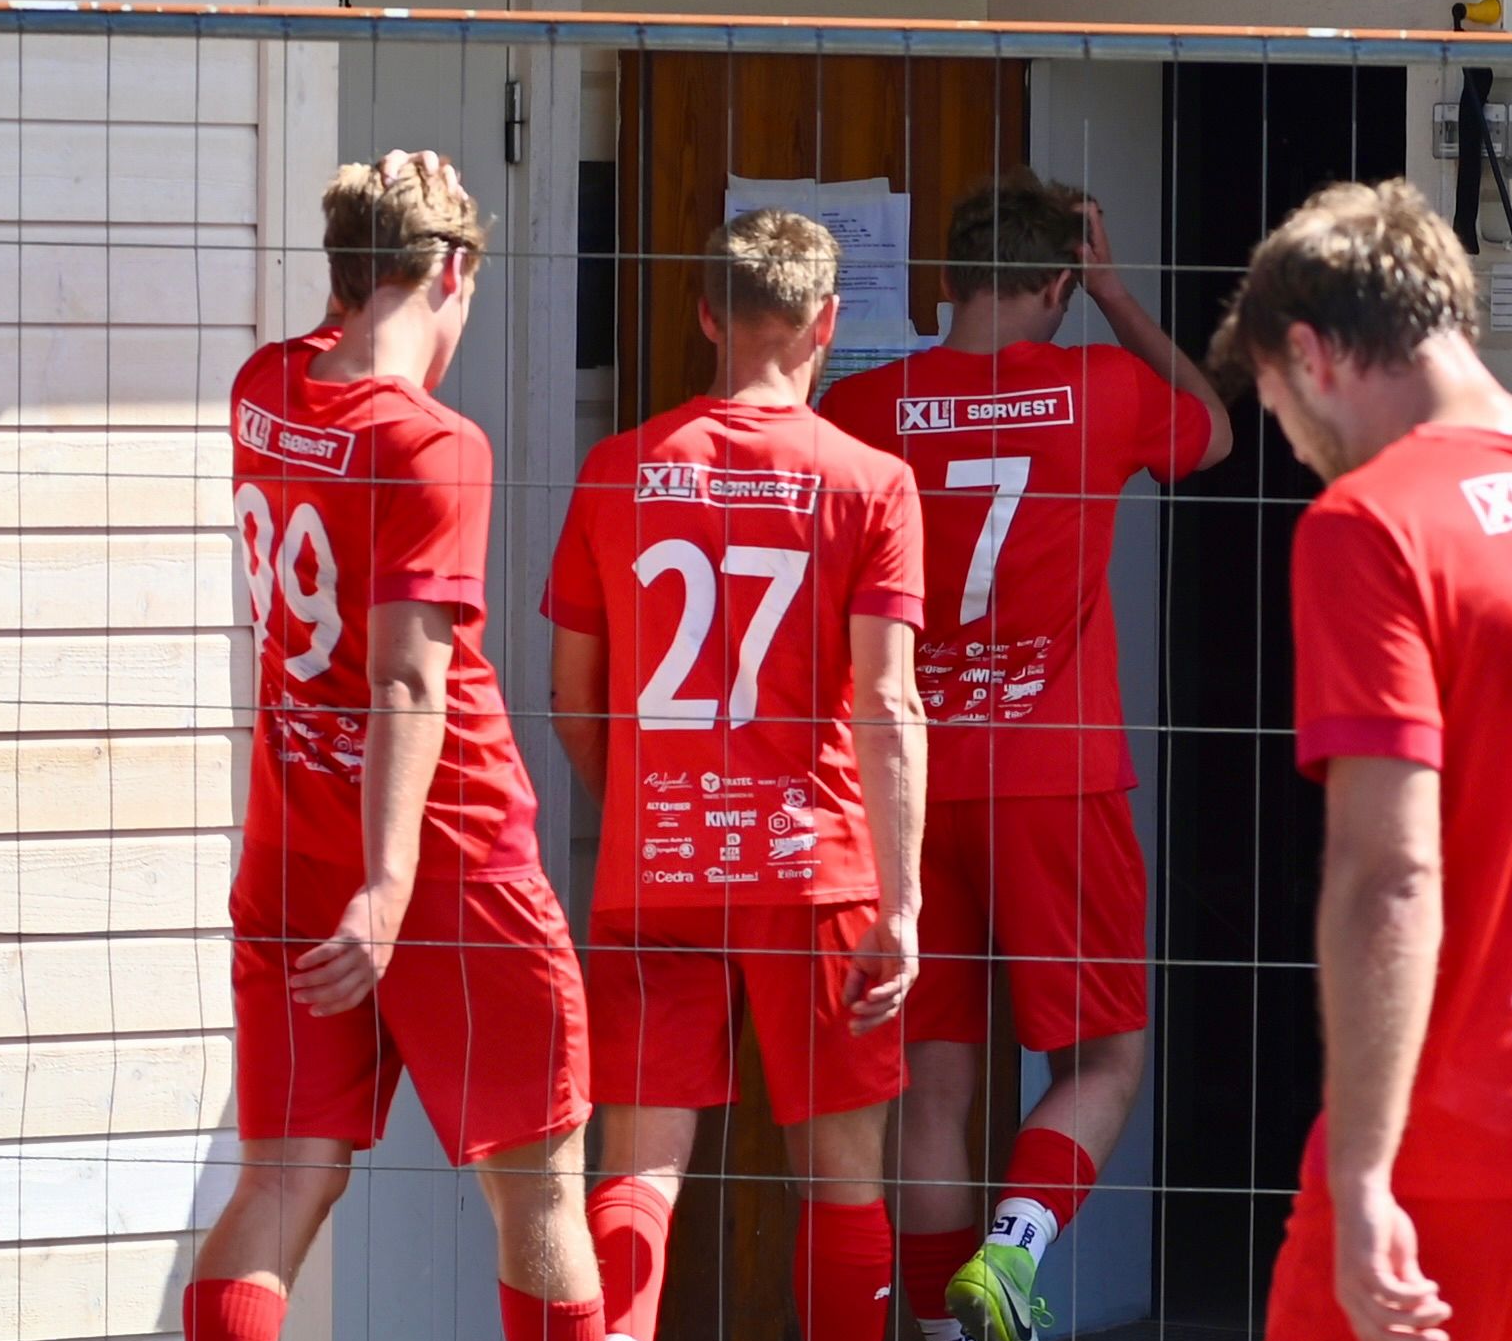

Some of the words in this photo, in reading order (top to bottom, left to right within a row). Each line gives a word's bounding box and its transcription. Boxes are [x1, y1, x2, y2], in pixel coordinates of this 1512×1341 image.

[901, 402, 949, 430] XL
[967, 399, 1057, 420] SØRVEST
[640, 468, 690, 497] XL
[709, 480, 802, 500] SØRVEST
[946, 456, 1030, 626] 7
[632, 539, 810, 730] 27
